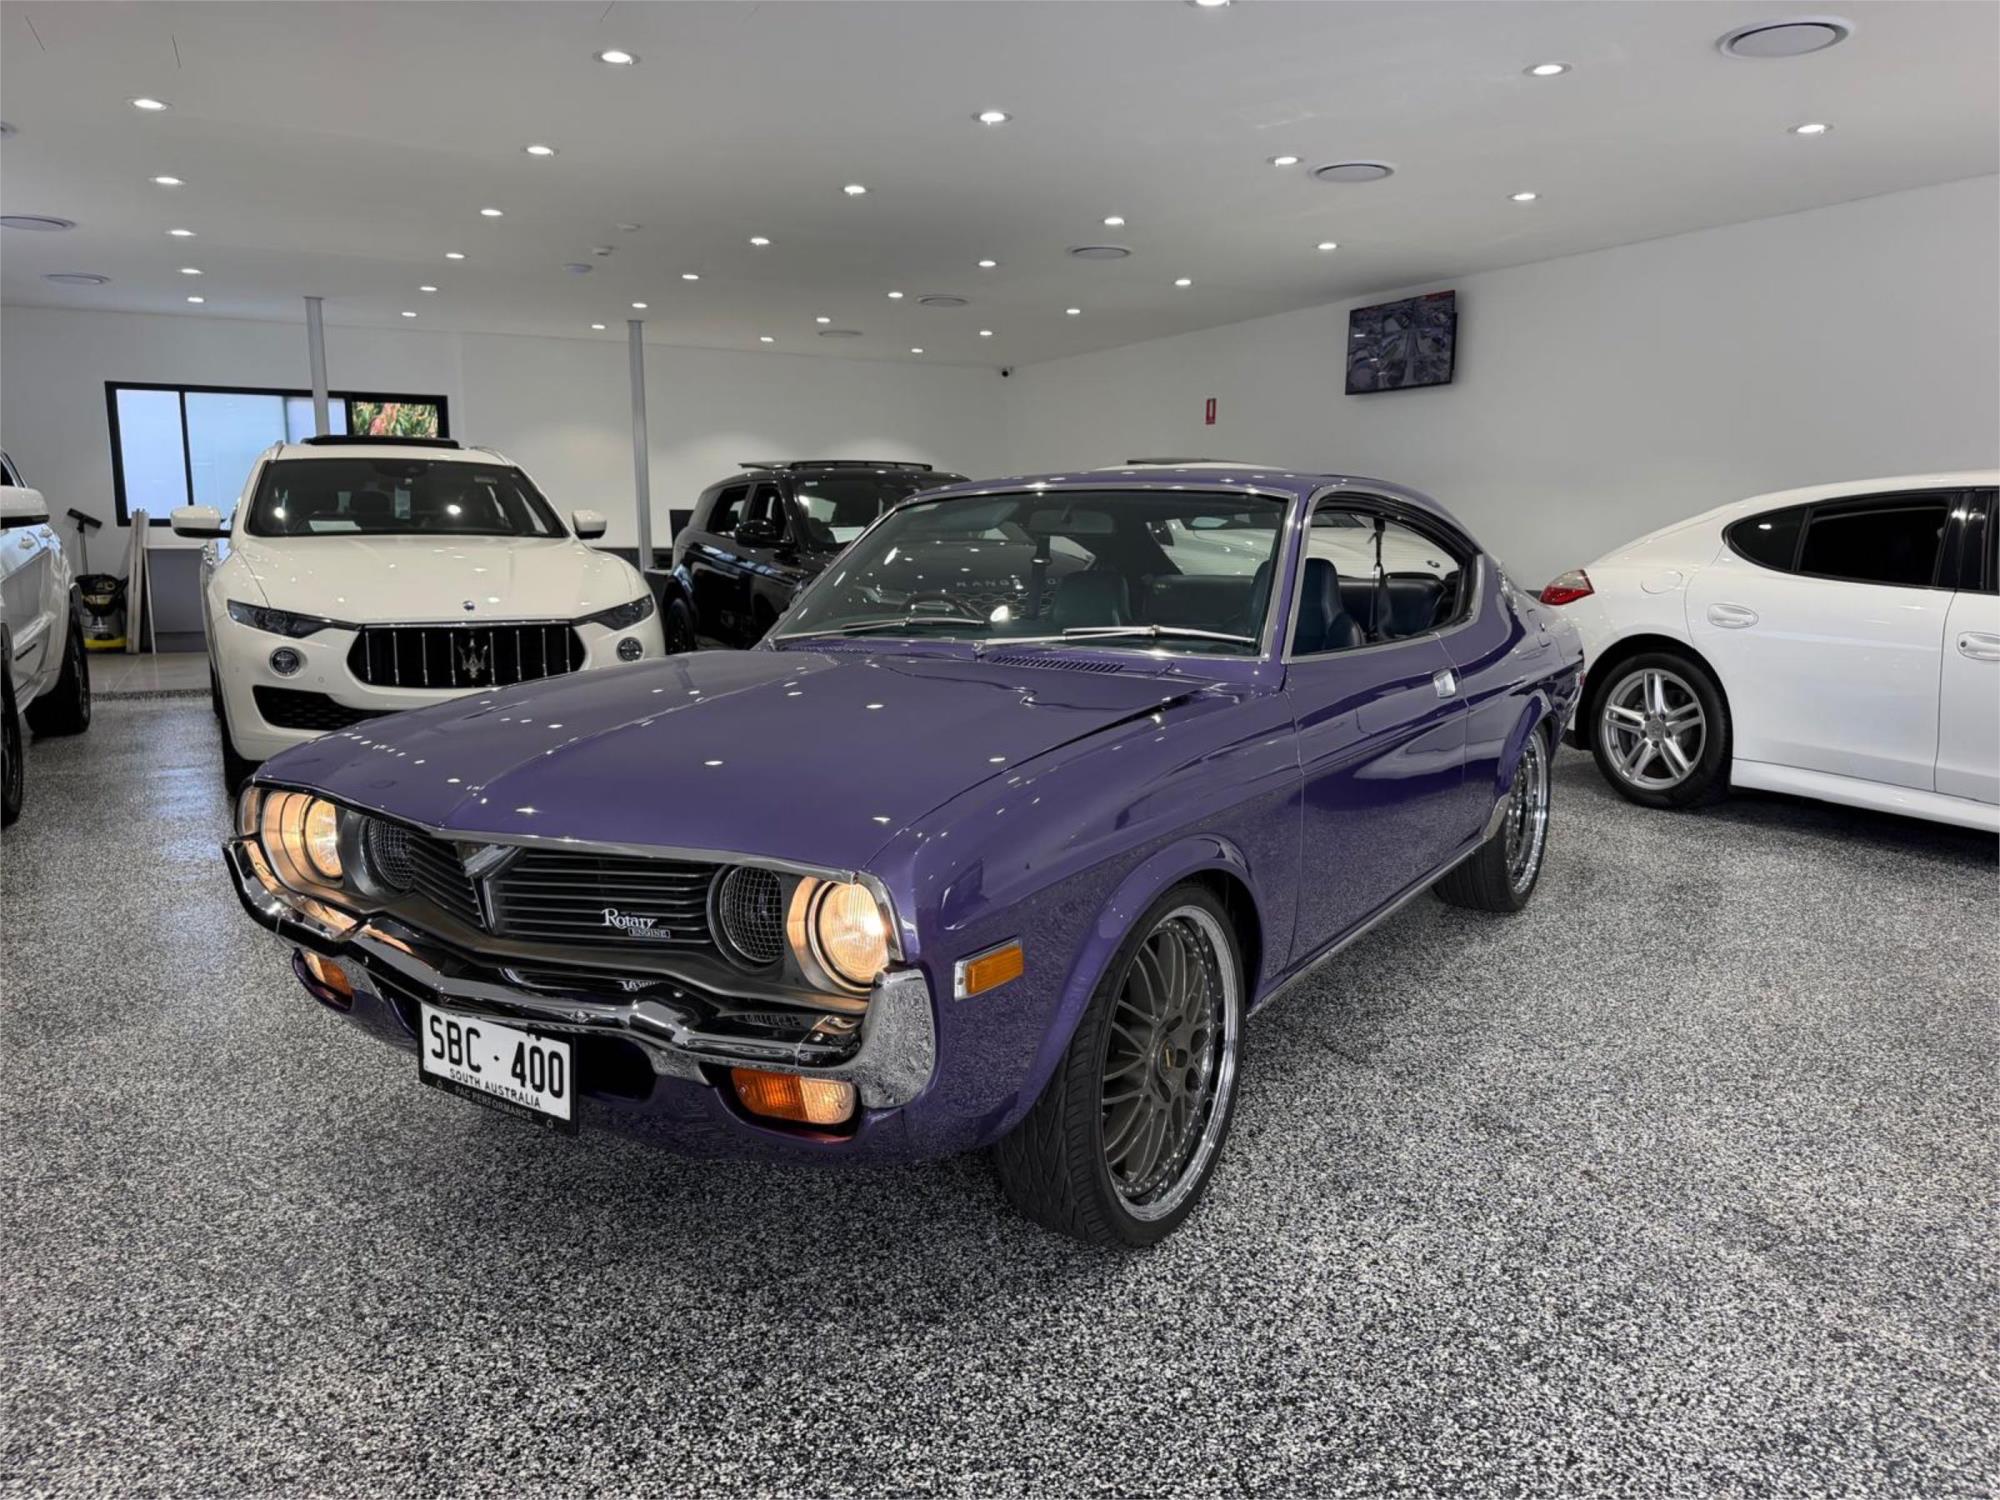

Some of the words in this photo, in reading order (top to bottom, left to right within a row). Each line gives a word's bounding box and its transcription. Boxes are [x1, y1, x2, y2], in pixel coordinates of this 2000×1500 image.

[601, 908, 658, 929] Rotary
[430, 1014, 482, 1073] SBC
[511, 1041, 564, 1099] 400
[449, 1068, 481, 1088] SOUTH
[484, 1081, 541, 1109] AUSTRALIA
[472, 1091, 532, 1120] PERFORMANCE
